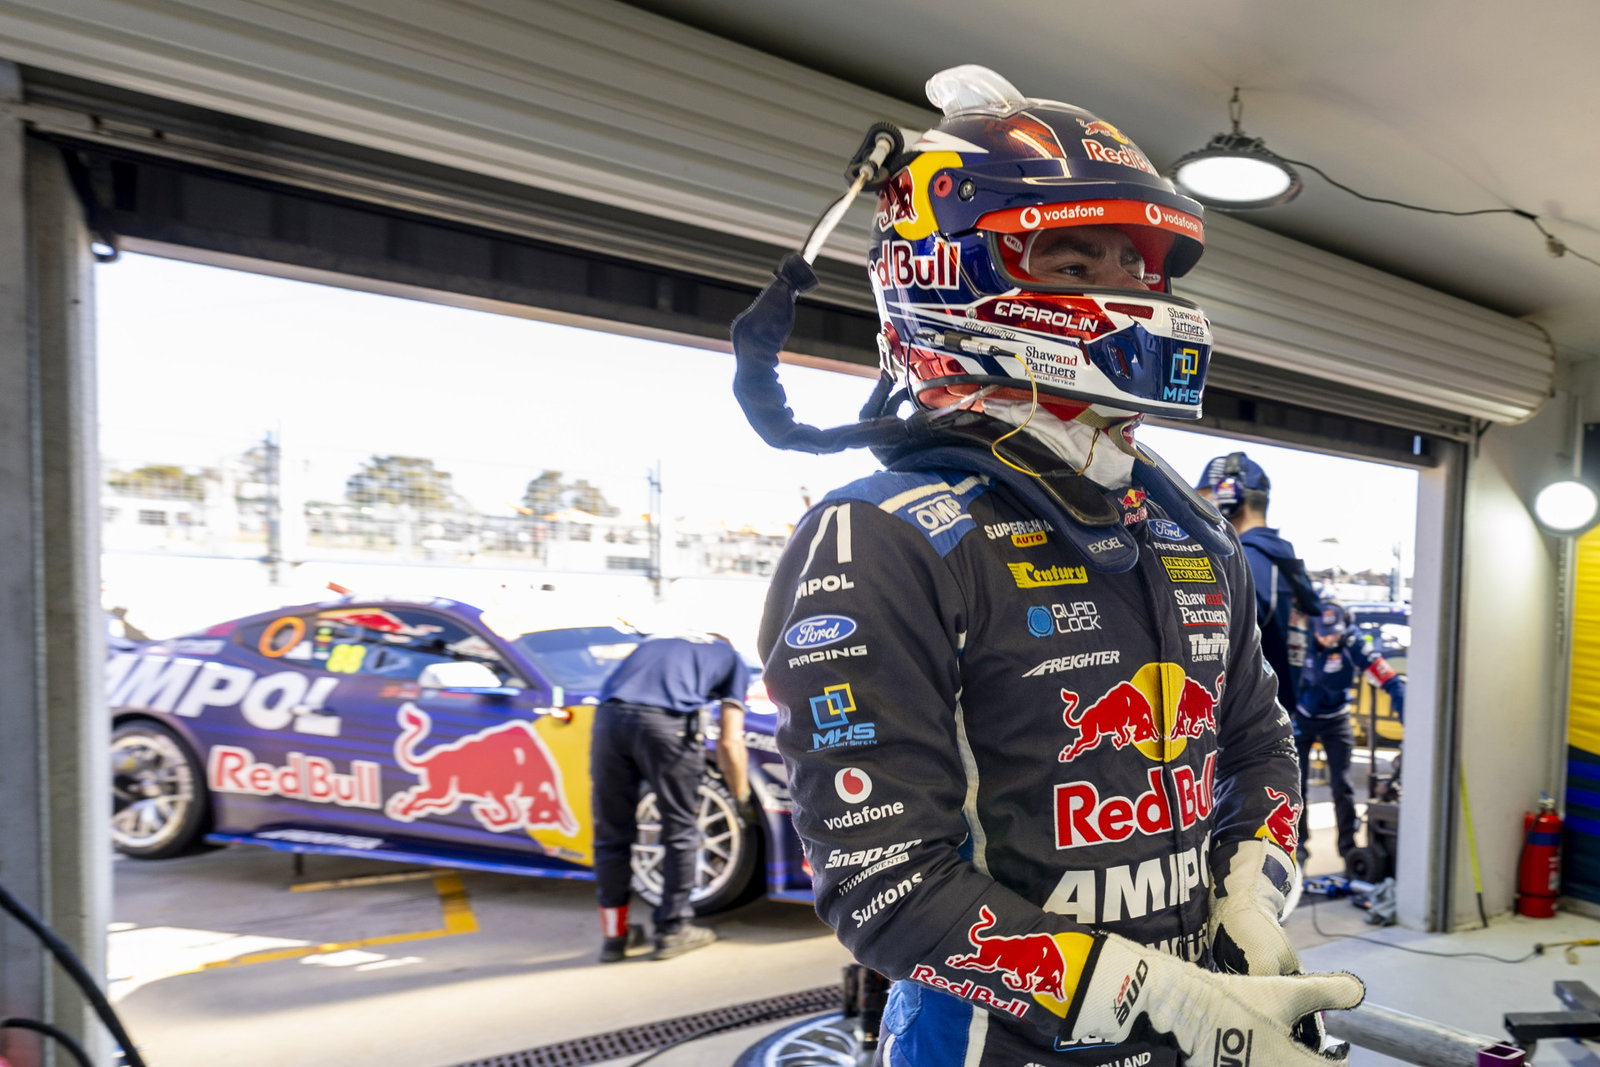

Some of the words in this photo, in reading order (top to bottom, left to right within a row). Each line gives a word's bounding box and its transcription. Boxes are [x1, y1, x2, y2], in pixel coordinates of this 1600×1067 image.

[1082, 139, 1137, 169] Red
[1044, 205, 1104, 221] vodafone
[1163, 213, 1199, 233] vodafone
[891, 239, 961, 290] Bull
[1171, 318, 1204, 336] Partners
[1024, 370, 1050, 381] Fancial
[1025, 358, 1076, 379] Partners
[1163, 386, 1200, 403] MHS
[915, 498, 962, 530] OMP
[1016, 534, 1043, 544] AUTO
[1155, 520, 1182, 538] Ford
[1153, 542, 1204, 552] RACING
[1163, 557, 1208, 568] NATIONAL
[1007, 562, 1088, 588] Century
[1170, 569, 1213, 580] STORAGE
[796, 574, 855, 600] MPOL
[1051, 601, 1097, 618] QUAD
[1179, 606, 1227, 624] Partners
[797, 620, 840, 645] Ford
[1056, 615, 1102, 633] LOCK
[788, 645, 868, 669] RACING
[1036, 650, 1120, 676] FREIGHTER
[812, 722, 876, 749] MHS
[207, 744, 306, 799] Red
[302, 755, 382, 809] Bull
[1054, 766, 1174, 850] Red
[1171, 750, 1217, 831] Bull
[824, 802, 904, 830] vodafone
[870, 854, 907, 875] EVENTS
[1042, 830, 1211, 924] AMP
[851, 872, 923, 928] Suttons
[910, 964, 975, 998] Red
[969, 985, 1030, 1018] Bull
